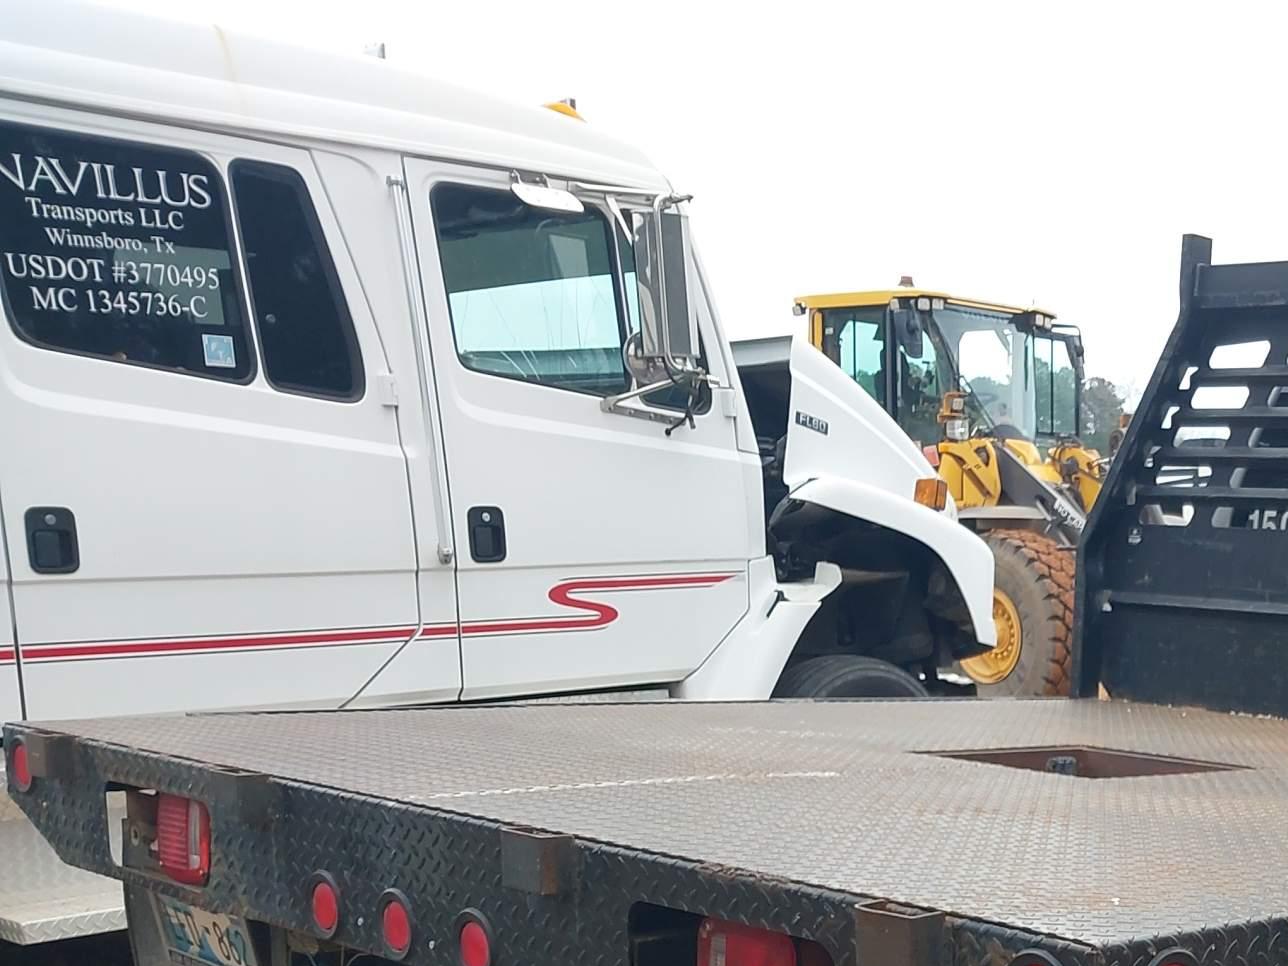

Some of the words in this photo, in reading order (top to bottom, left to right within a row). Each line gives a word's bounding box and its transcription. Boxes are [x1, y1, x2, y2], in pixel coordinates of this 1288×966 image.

[0, 153, 212, 208] NAVILLUS
[24, 196, 135, 228] Transports
[139, 207, 184, 230] LLC
[44, 227, 148, 254] Winnsboro,
[150, 235, 176, 254] Tx
[4, 252, 104, 282] USDOT
[112, 260, 220, 290] #3770495
[30, 286, 78, 312] MC
[85, 289, 209, 319] 1345736-C
